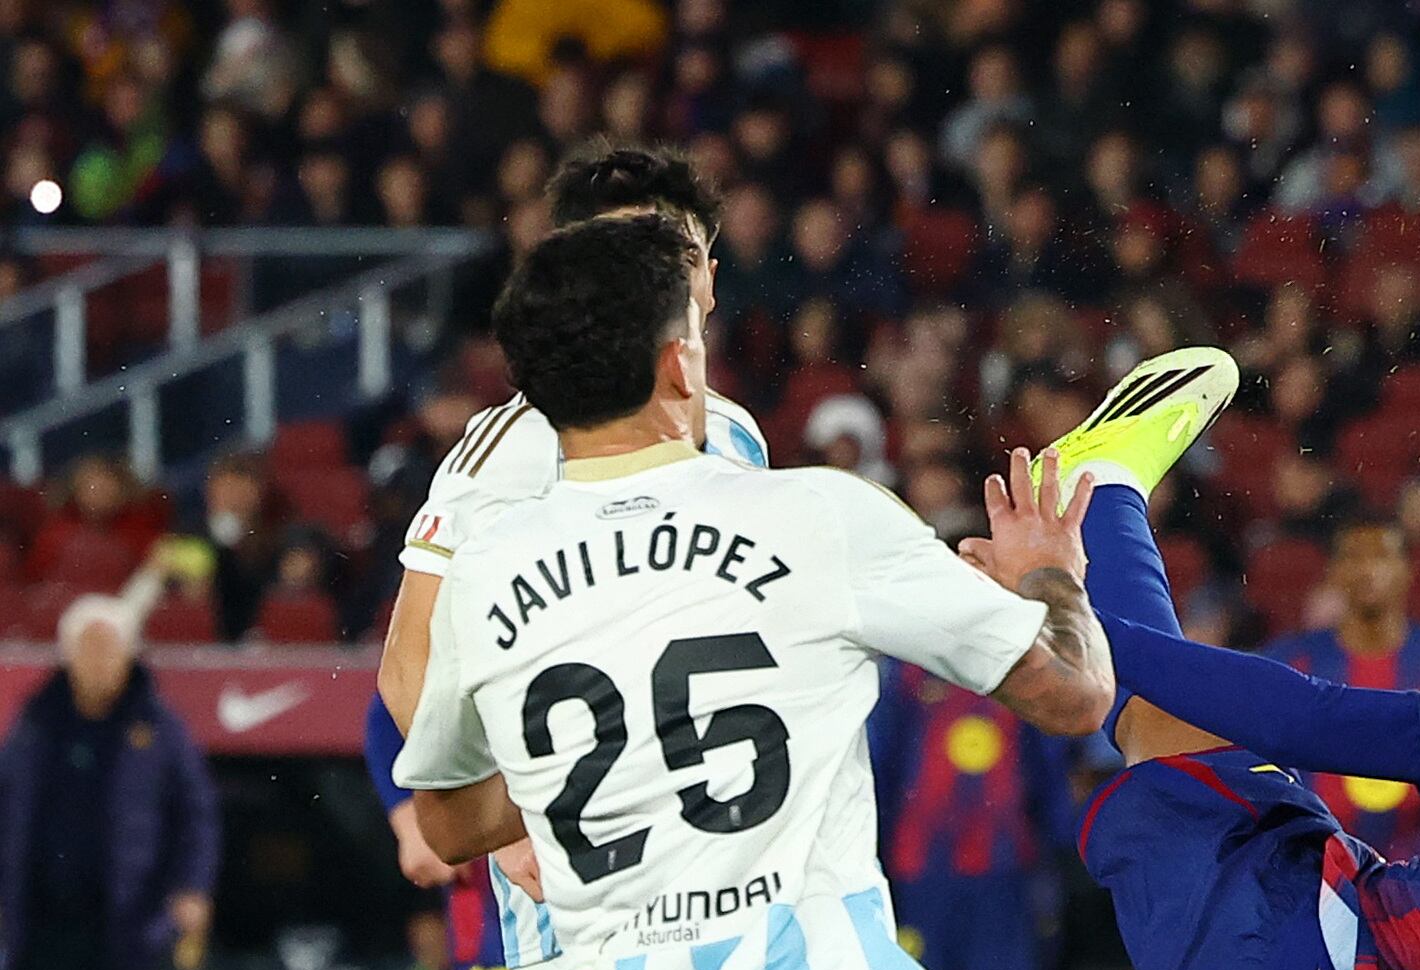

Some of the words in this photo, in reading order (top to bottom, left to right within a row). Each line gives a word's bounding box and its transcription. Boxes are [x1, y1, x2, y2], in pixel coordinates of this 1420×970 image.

[487, 541, 595, 650] JAVI
[615, 512, 792, 602] LÓPEZ
[521, 631, 791, 885] 25
[624, 871, 782, 931] YUNDAI
[636, 921, 700, 947] Asturdai
